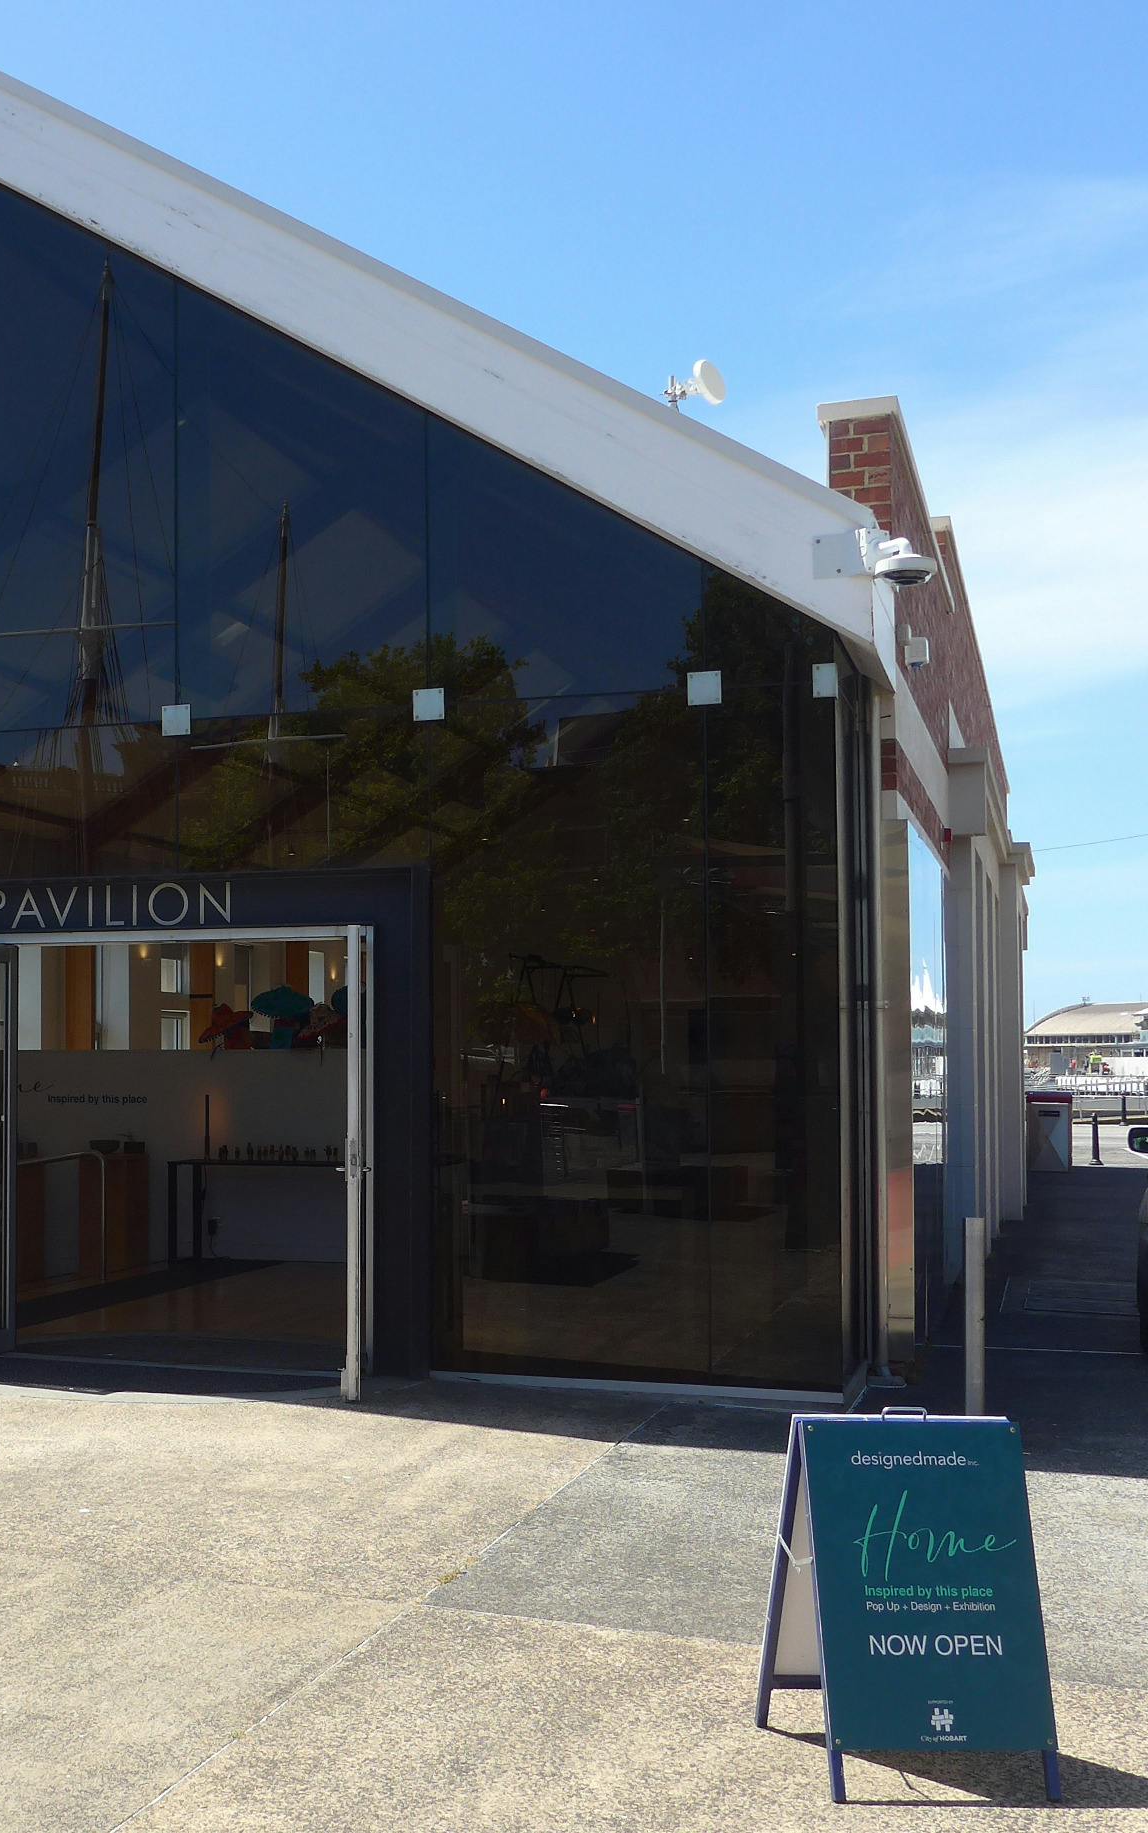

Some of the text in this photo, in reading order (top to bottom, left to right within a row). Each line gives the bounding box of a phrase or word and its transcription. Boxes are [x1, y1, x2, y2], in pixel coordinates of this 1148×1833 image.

[48, 1094, 148, 1106] Inspired by this place
[851, 1450, 967, 1469] designedmade
[853, 1490, 1017, 1582] Home
[864, 1585, 994, 1599] Inspired by this place
[866, 1601, 885, 1612] Pop
[886, 1601, 900, 1612] Up
[910, 1601, 942, 1613] Design
[953, 1601, 996, 1612] Exhibition
[869, 1634, 1003, 1656] NOW OPEN
